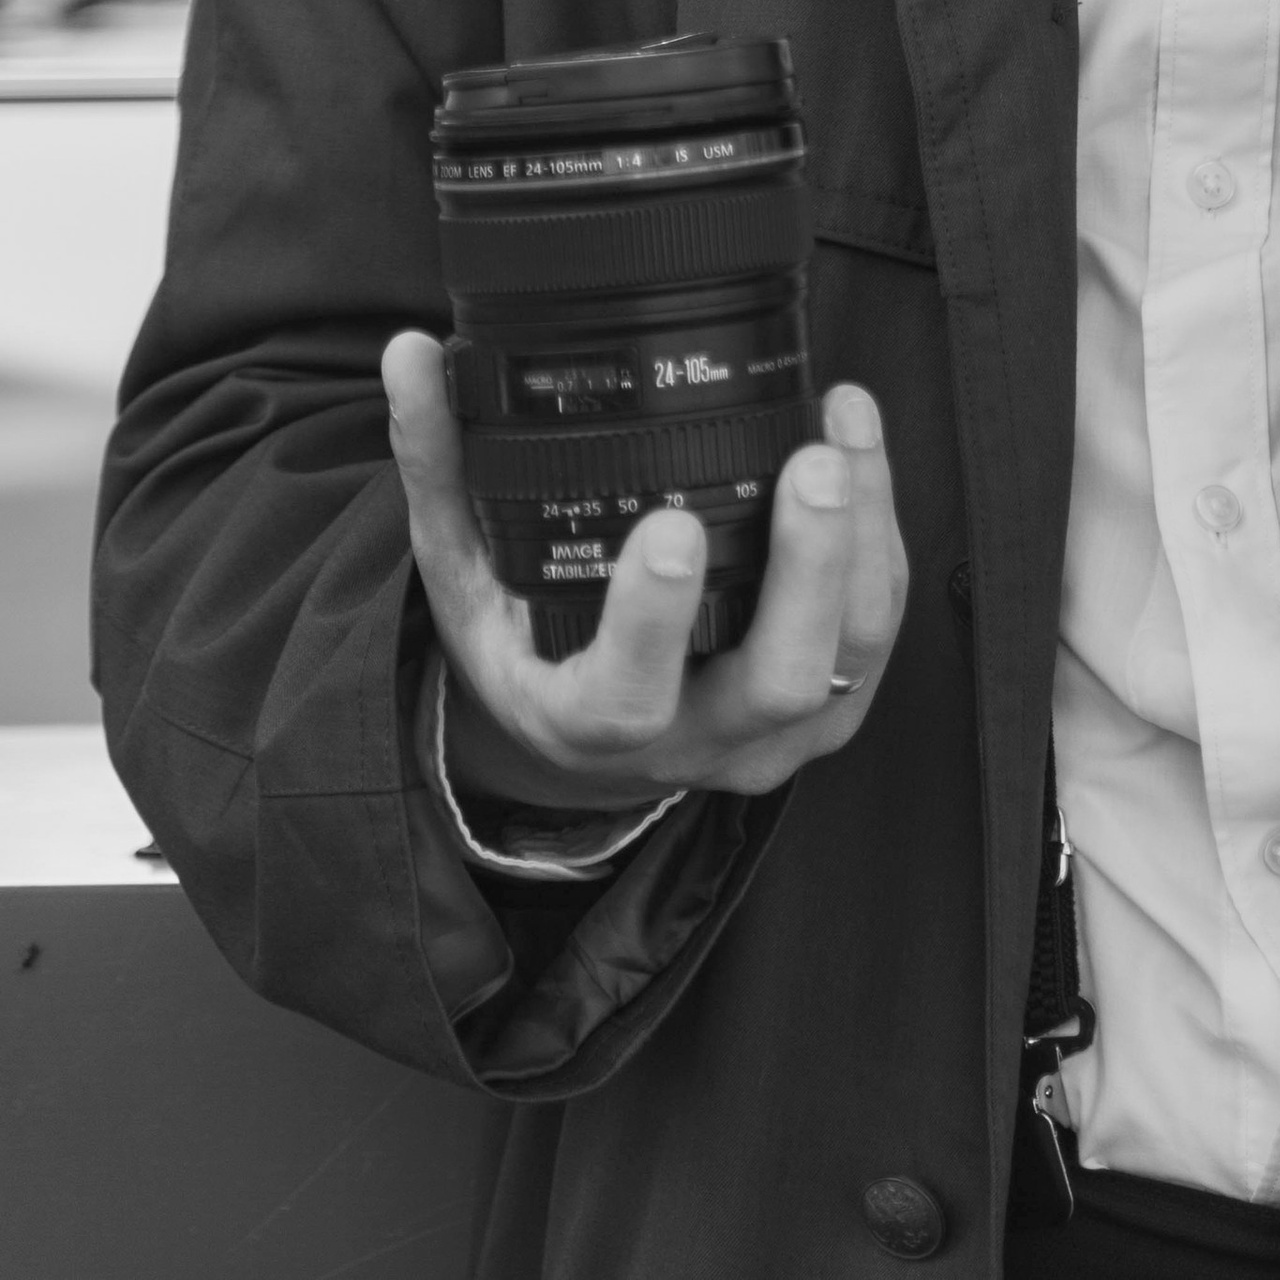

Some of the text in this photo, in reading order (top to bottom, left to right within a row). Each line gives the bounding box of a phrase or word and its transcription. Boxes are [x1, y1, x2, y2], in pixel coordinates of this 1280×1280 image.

[468, 165, 494, 179] LENS
[502, 163, 517, 178] EF
[525, 159, 603, 177] 24-105mm
[675, 148, 689, 163] IS
[702, 141, 735, 160] USM
[654, 356, 729, 389] 24-105mm
[542, 480, 758, 519] 24 35 50 70 105
[551, 542, 602, 560] IMAGE
